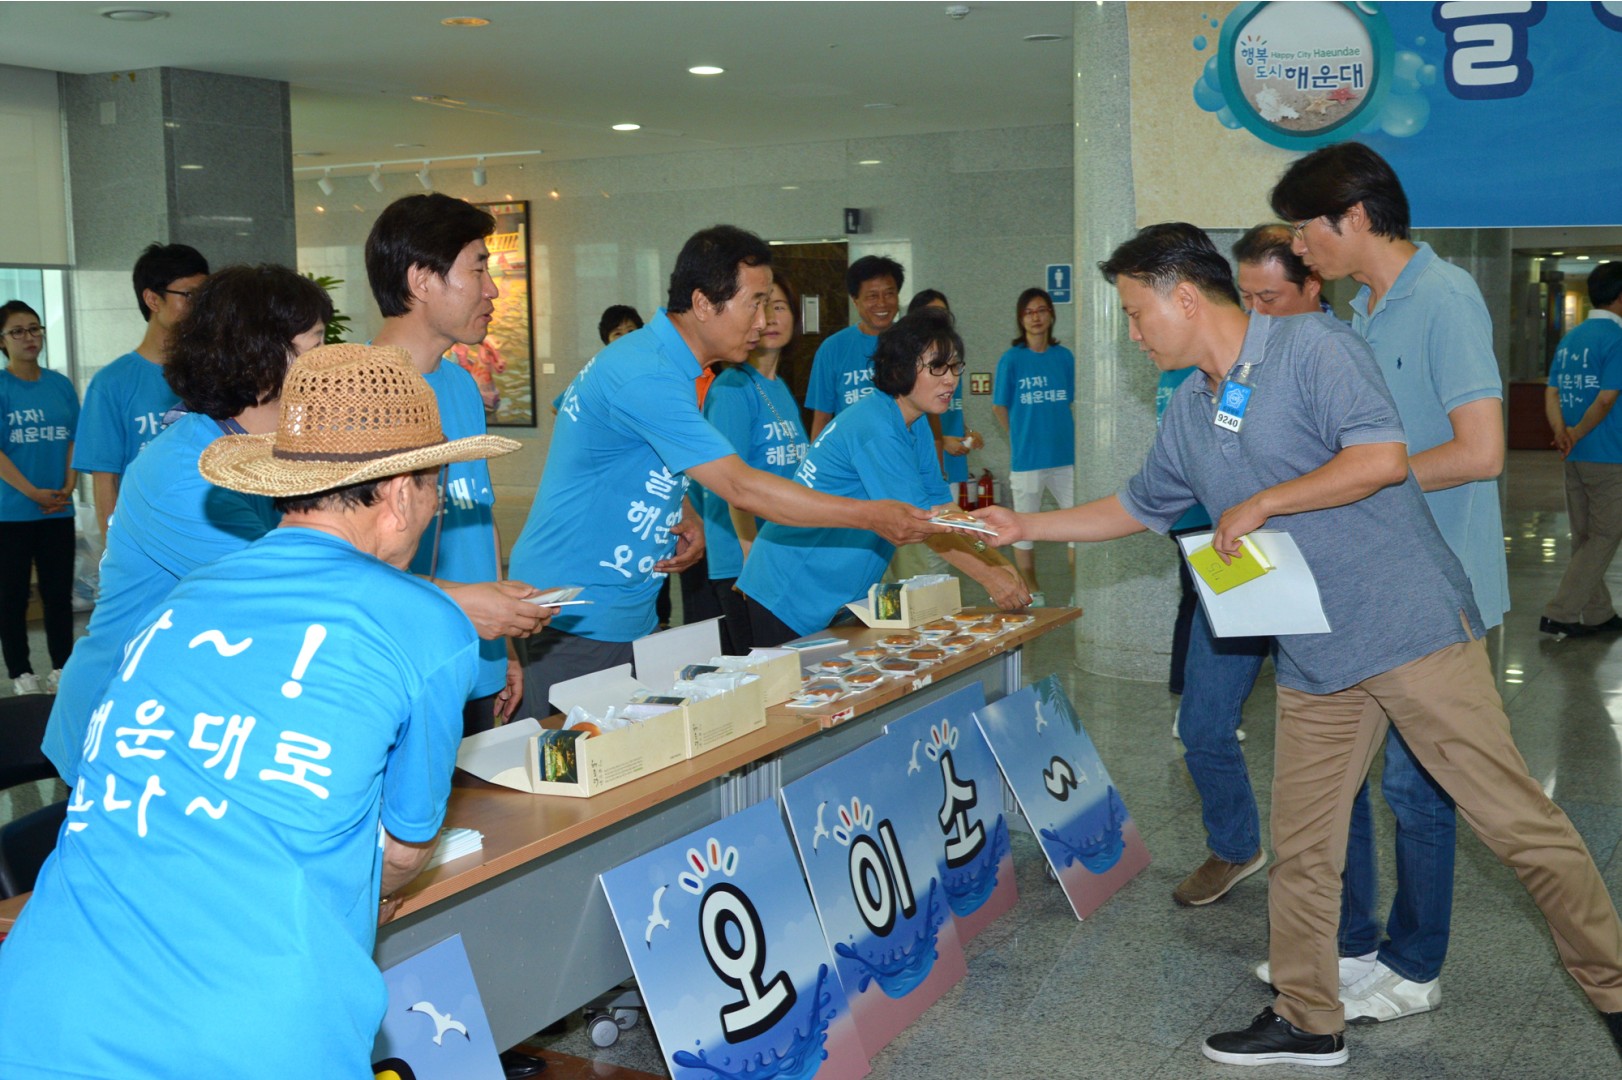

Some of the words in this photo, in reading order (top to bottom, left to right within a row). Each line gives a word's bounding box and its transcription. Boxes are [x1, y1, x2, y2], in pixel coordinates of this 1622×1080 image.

[1241, 47, 1268, 66] 행복
[1271, 51, 1295, 60] Happy
[1297, 50, 1311, 59] City
[1313, 45, 1360, 58] Haeundae
[1256, 63, 1282, 78] 도시
[1285, 63, 1363, 89] 해운대
[1019, 376, 1048, 390] 가자!
[1019, 389, 1068, 405] 해운대로
[7, 408, 46, 425] 가자!
[1217, 412, 1239, 428] 9240
[9, 425, 69, 444] 해운대로
[765, 443, 810, 466] 해운대
[938, 749, 987, 869] 소
[849, 818, 917, 938] 이
[698, 882, 798, 1045] 오
